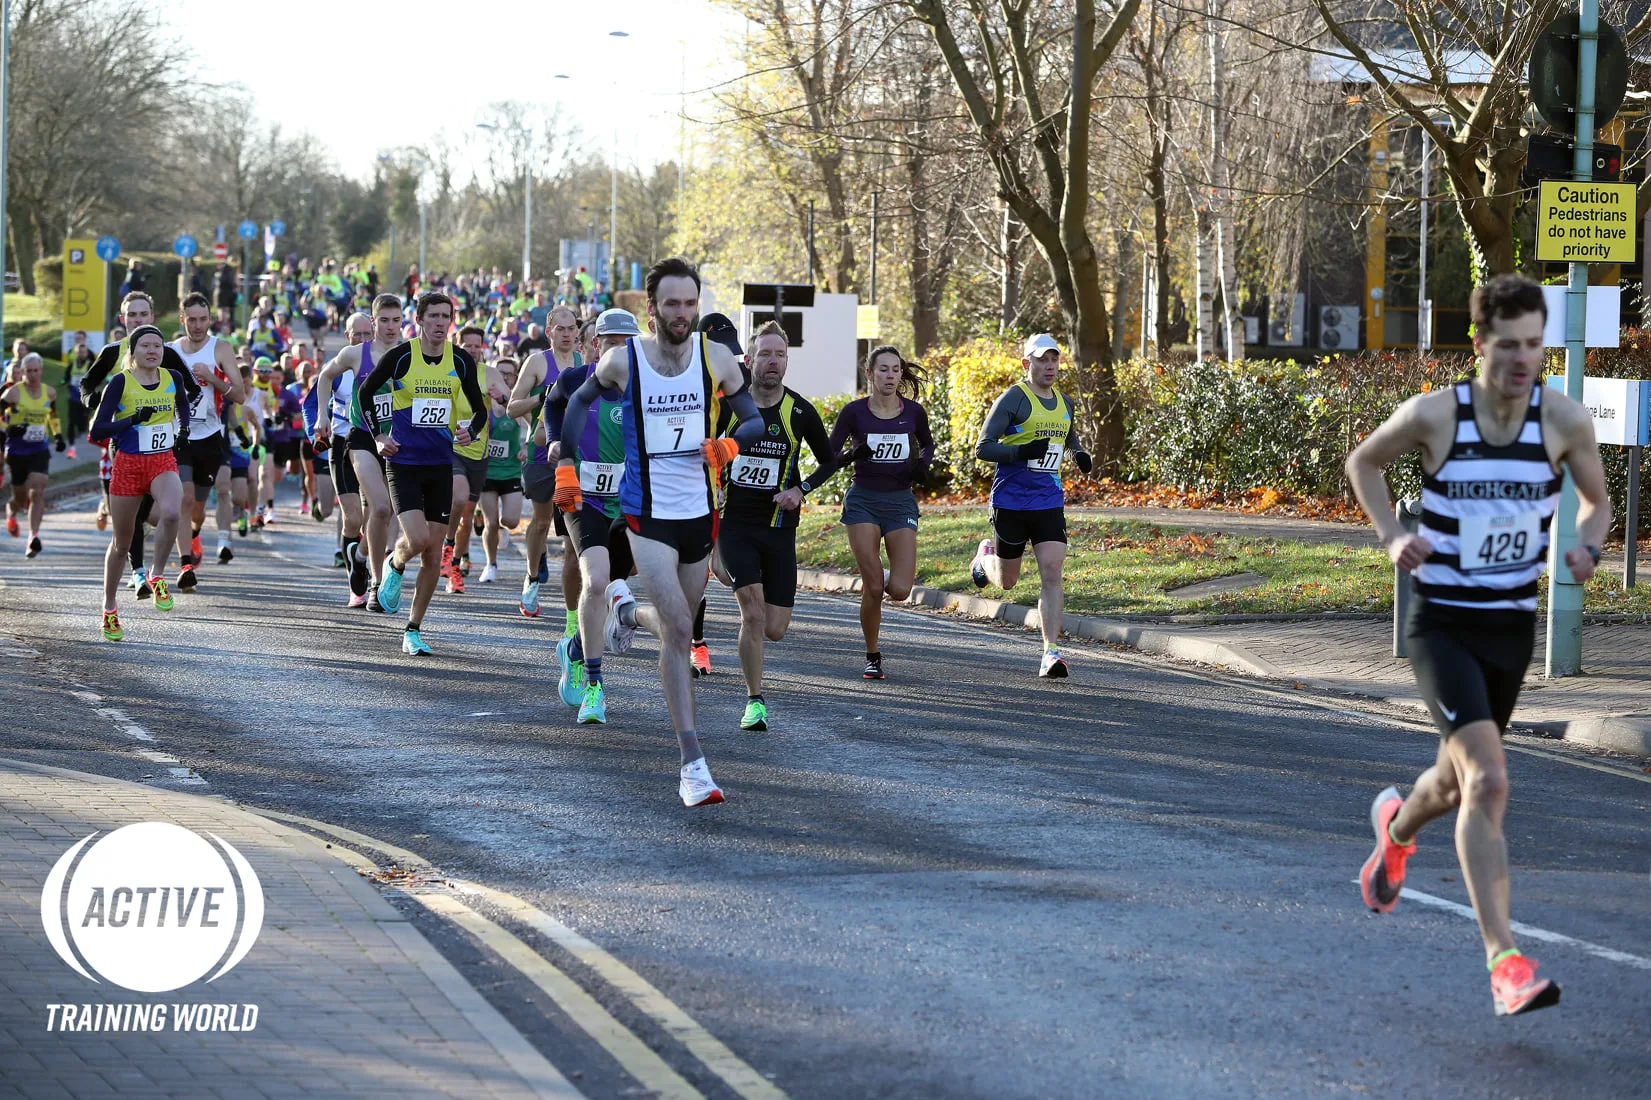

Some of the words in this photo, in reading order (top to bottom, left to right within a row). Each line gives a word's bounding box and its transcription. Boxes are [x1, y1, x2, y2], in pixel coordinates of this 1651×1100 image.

[1558, 187, 1619, 204] Caution
[1549, 207, 1627, 222] Pedestrians
[1548, 224, 1565, 238] do
[1569, 226, 1591, 238] not
[1595, 225, 1626, 239] have
[71, 250, 82, 263] P
[1563, 242, 1611, 259] priority
[68, 288, 89, 316] B
[415, 386, 452, 395] STRIDERS
[648, 393, 698, 405] LUTON
[420, 407, 446, 424] 252
[647, 406, 682, 414] Athletic
[683, 404, 701, 412] Club
[1600, 404, 1615, 419] Lane
[151, 432, 167, 450] 62
[673, 427, 684, 451] 7
[1035, 430, 1067, 439] STRIDERS
[750, 446, 786, 456] RUNNERS
[760, 440, 787, 450] HERTS
[875, 443, 902, 459] 670
[1037, 452, 1059, 469] 477
[595, 473, 614, 492] 91
[737, 465, 770, 484] 249
[1447, 482, 1549, 500] HIGHGATE
[1478, 531, 1528, 564] 429
